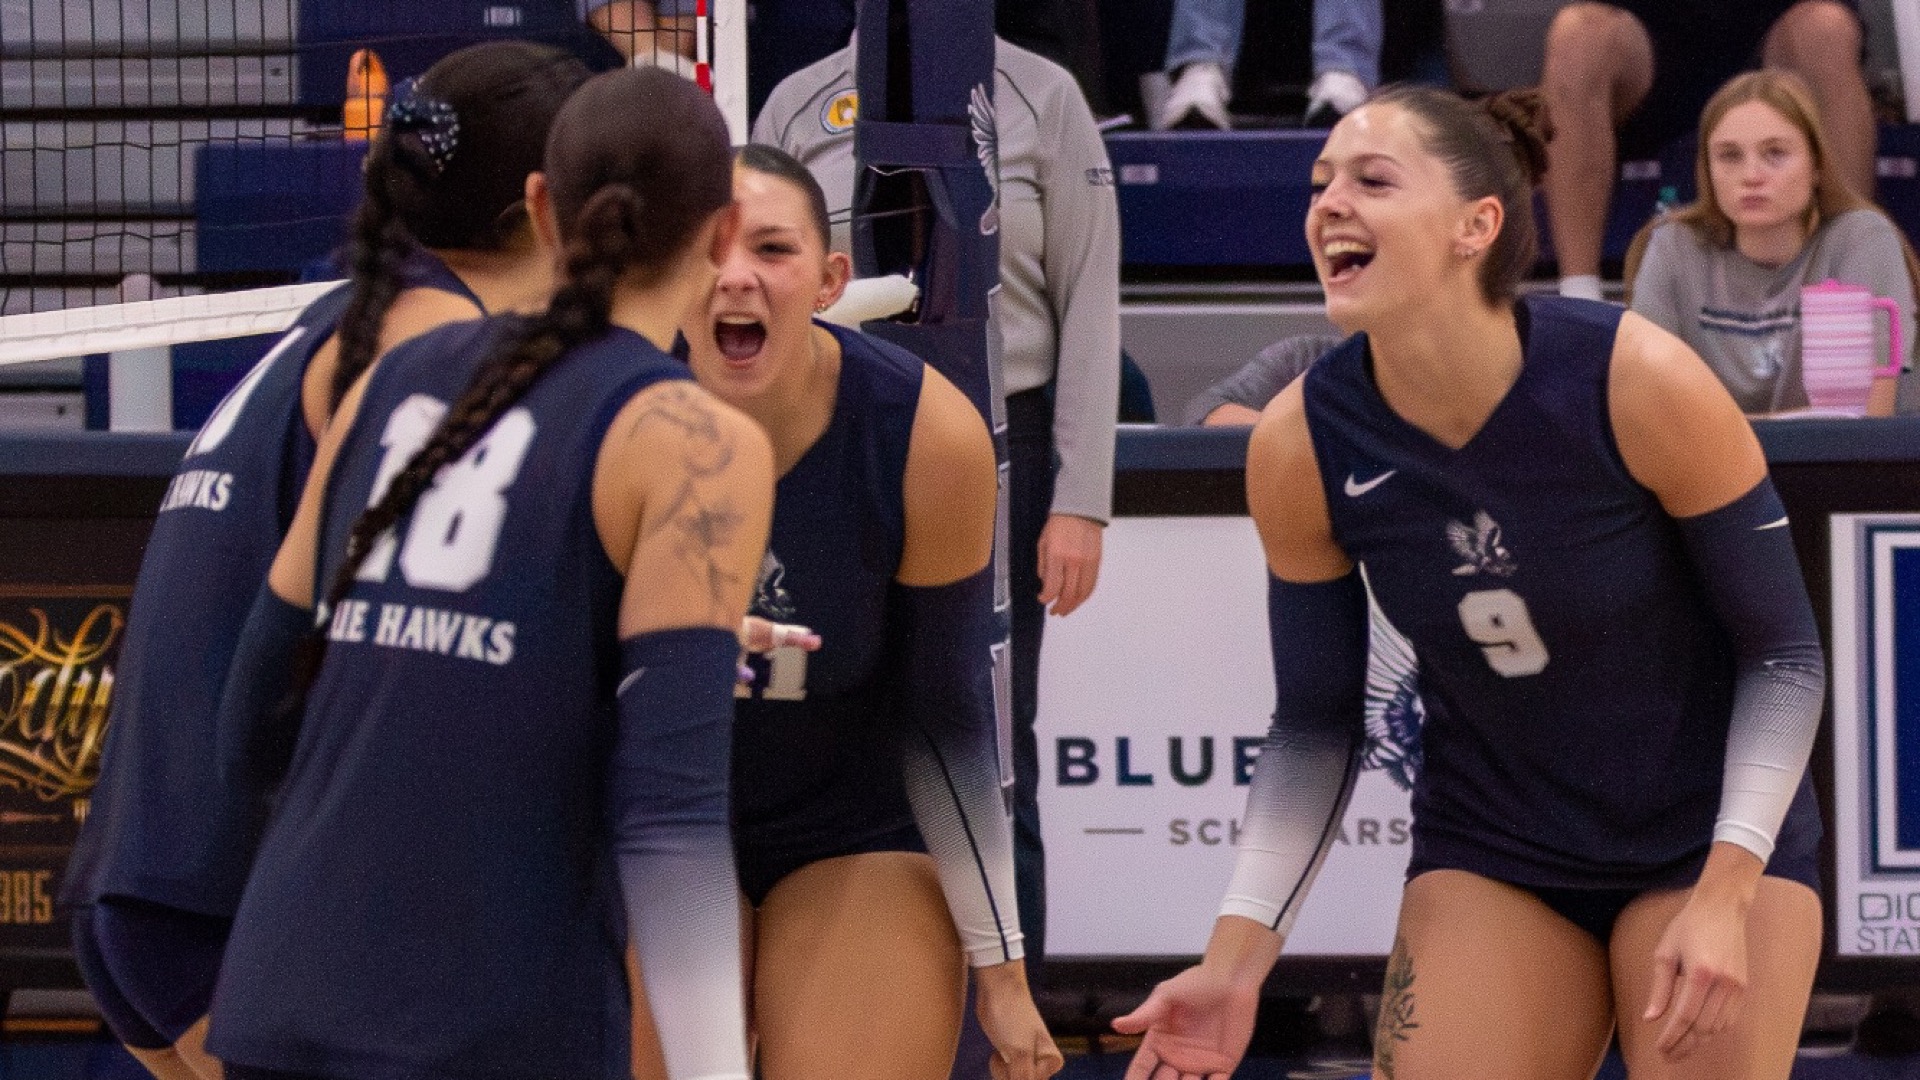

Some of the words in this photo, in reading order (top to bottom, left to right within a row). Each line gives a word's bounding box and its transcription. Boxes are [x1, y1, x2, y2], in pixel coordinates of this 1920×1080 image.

[348, 393, 537, 592] 18
[374, 603, 516, 665] HAWKS
[1458, 588, 1550, 678] 9
[1056, 736, 1270, 786] BLUE
